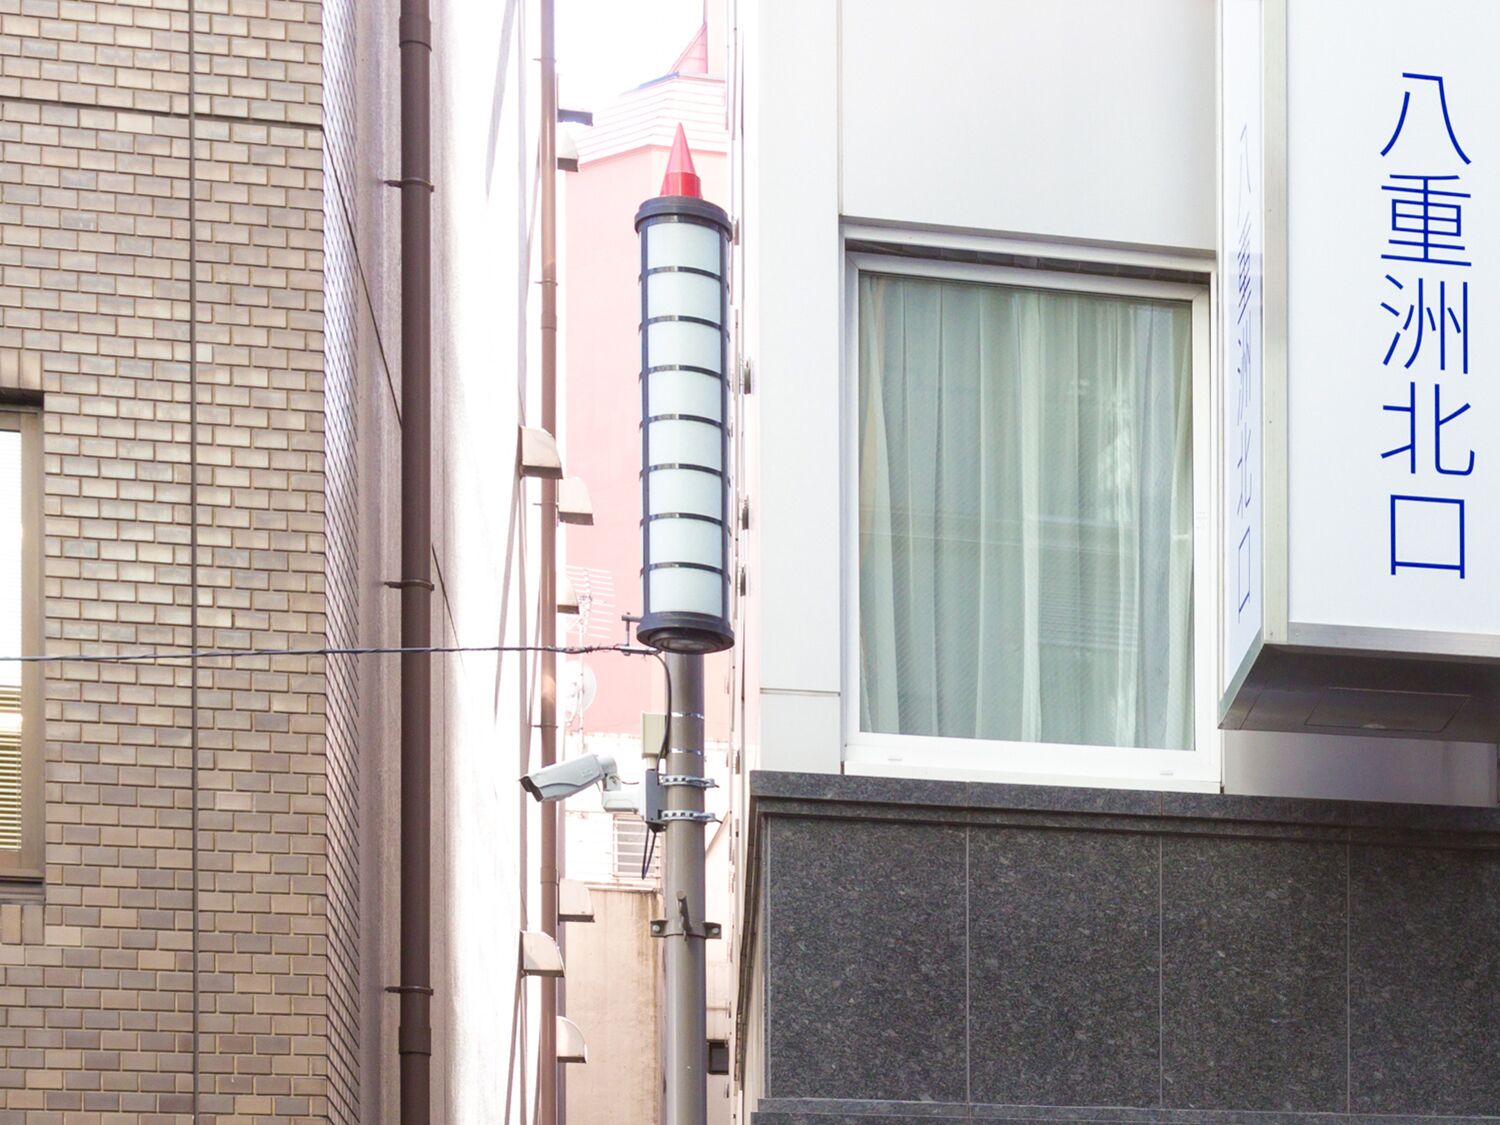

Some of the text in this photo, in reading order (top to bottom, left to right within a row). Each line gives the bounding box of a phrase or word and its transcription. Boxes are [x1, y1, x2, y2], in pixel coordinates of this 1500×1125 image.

[1237, 123, 1252, 624] 八重洲北口
[1380, 71, 1475, 579] 八重洲北口
